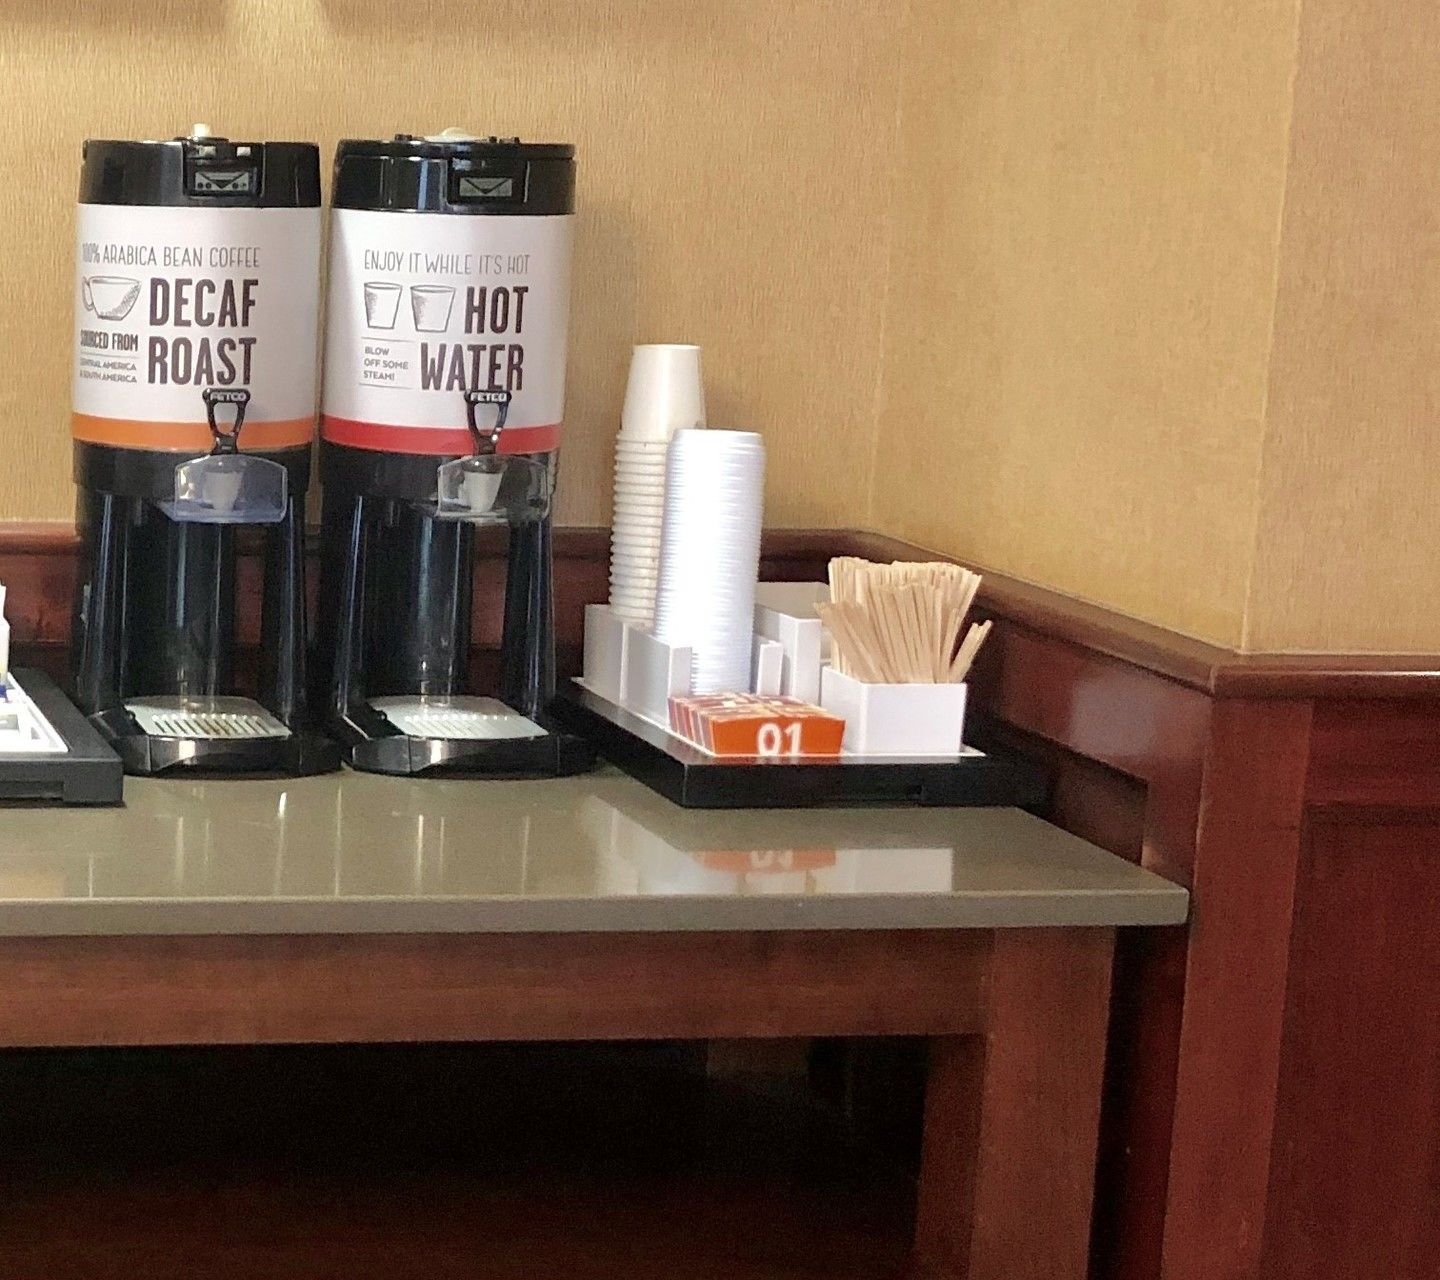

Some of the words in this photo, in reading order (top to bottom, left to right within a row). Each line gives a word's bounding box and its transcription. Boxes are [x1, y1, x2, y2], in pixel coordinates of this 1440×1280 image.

[103, 244, 157, 266] ARABICA
[163, 246, 203, 268] BEAN
[209, 246, 261, 268] COFFEE
[364, 249, 404, 272] ENJOY
[409, 252, 422, 273] IT
[425, 253, 472, 275] WHILE
[479, 254, 503, 275] IT'S
[507, 254, 531, 275] HOT
[149, 278, 259, 328] DECAF
[464, 285, 529, 334] HOT
[112, 333, 138, 351] FROM
[364, 346, 390, 356] BLOW
[147, 336, 257, 386] ROAST
[363, 358, 381, 367] OFF
[382, 360, 409, 370] SOME
[420, 342, 525, 391] WATER
[757, 721, 803, 756] 01
